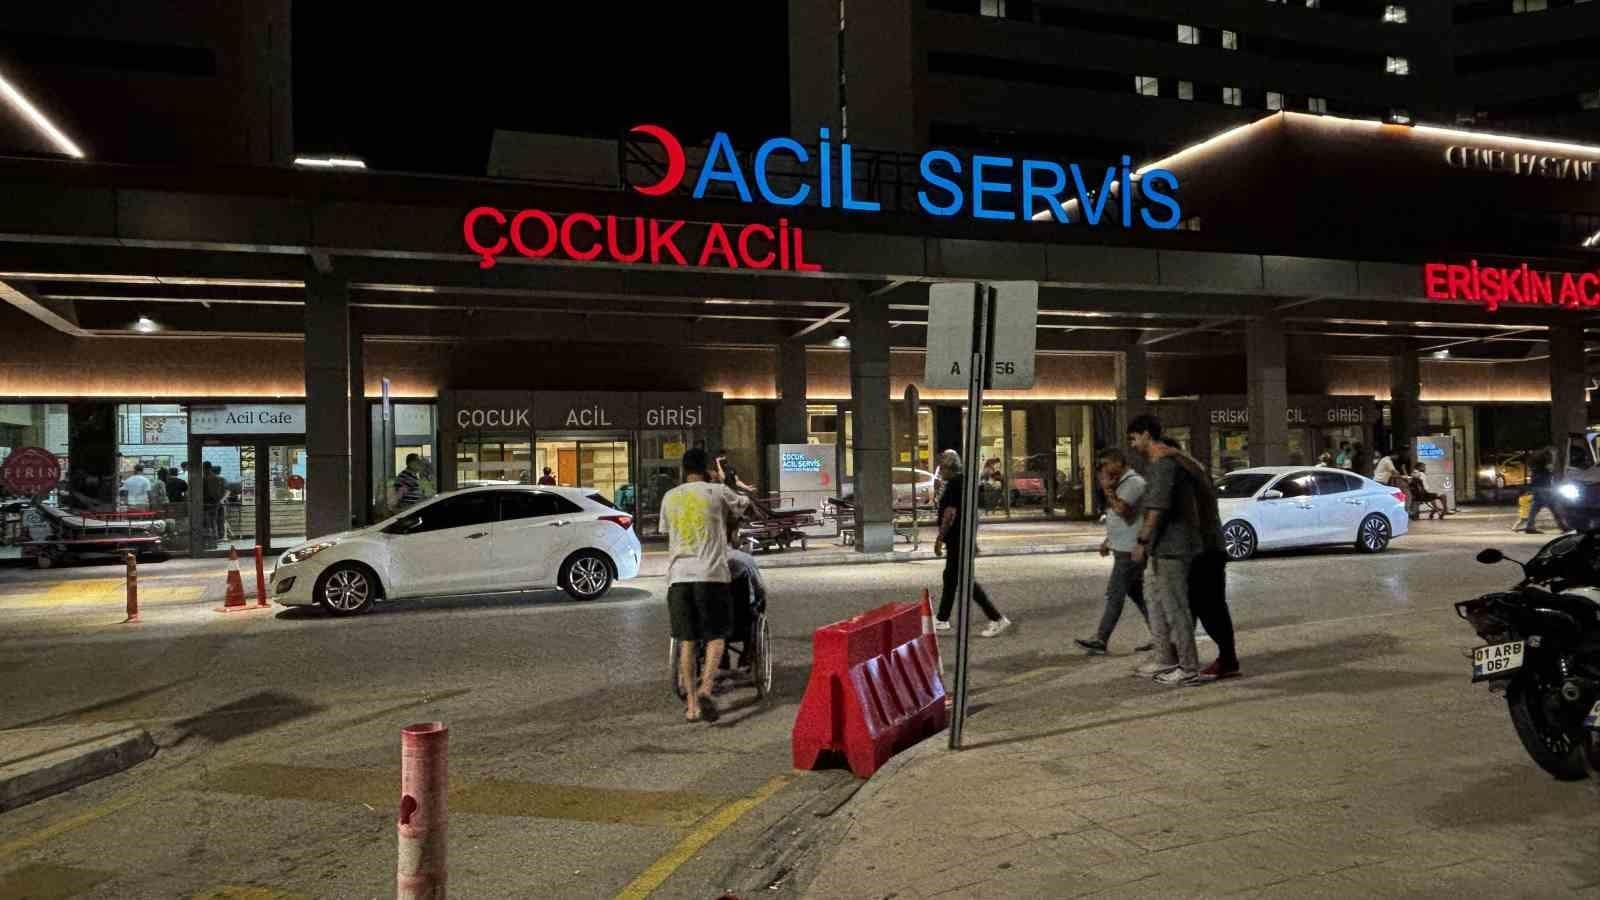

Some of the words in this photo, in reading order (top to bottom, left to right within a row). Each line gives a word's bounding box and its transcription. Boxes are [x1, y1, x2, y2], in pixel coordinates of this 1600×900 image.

[692, 127, 881, 212] ACİL
[917, 150, 1182, 231] SERVİS
[463, 206, 689, 269] ÇOCUK
[701, 218, 823, 272] ACİL
[1424, 259, 1552, 312] ERİŞKİN
[950, 361, 961, 376] A
[994, 361, 1015, 375] 56
[225, 411, 254, 425] Acil
[257, 411, 293, 425] Cafe
[457, 409, 530, 428] ÇOCUK
[566, 405, 612, 426] ACİL
[646, 405, 702, 427] GİRİŞİ
[1210, 408, 1249, 424] ERİŞKİ
[1286, 408, 1306, 422] CİL
[4, 466, 58, 479] FIRIN
[1476, 648, 1490, 662] 01
[1494, 643, 1522, 659] ARB
